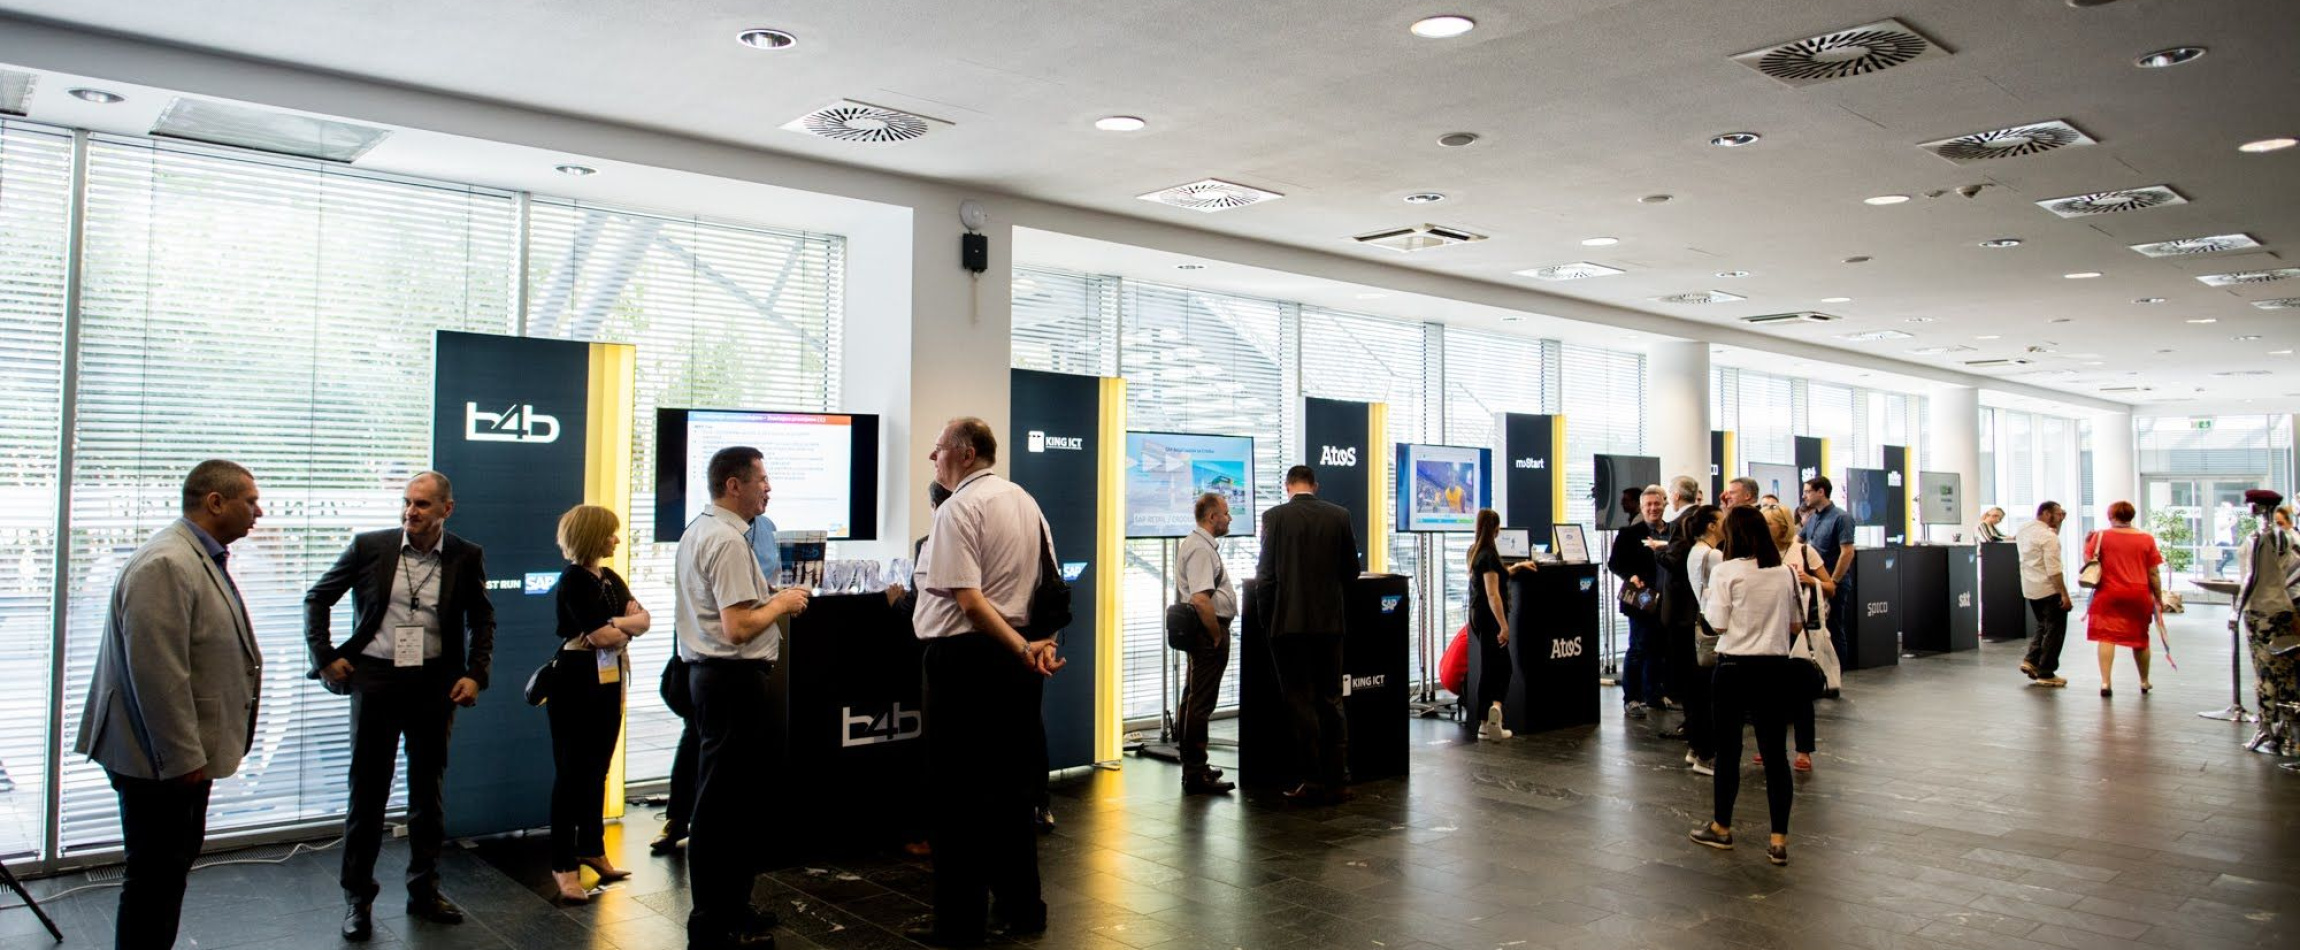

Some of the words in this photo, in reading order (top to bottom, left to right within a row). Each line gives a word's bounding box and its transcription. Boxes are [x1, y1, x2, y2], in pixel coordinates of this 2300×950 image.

[465, 402, 560, 443] b4b
[1045, 436, 1067, 447] KING
[1068, 438, 1082, 448] ICT
[485, 580, 499, 590] ST
[500, 579, 522, 589] RUN
[526, 575, 556, 591] SAP
[1381, 599, 1398, 611] SAP
[1352, 676, 1372, 688] KING
[1373, 674, 1385, 686] ICT
[842, 701, 922, 748] b4b
